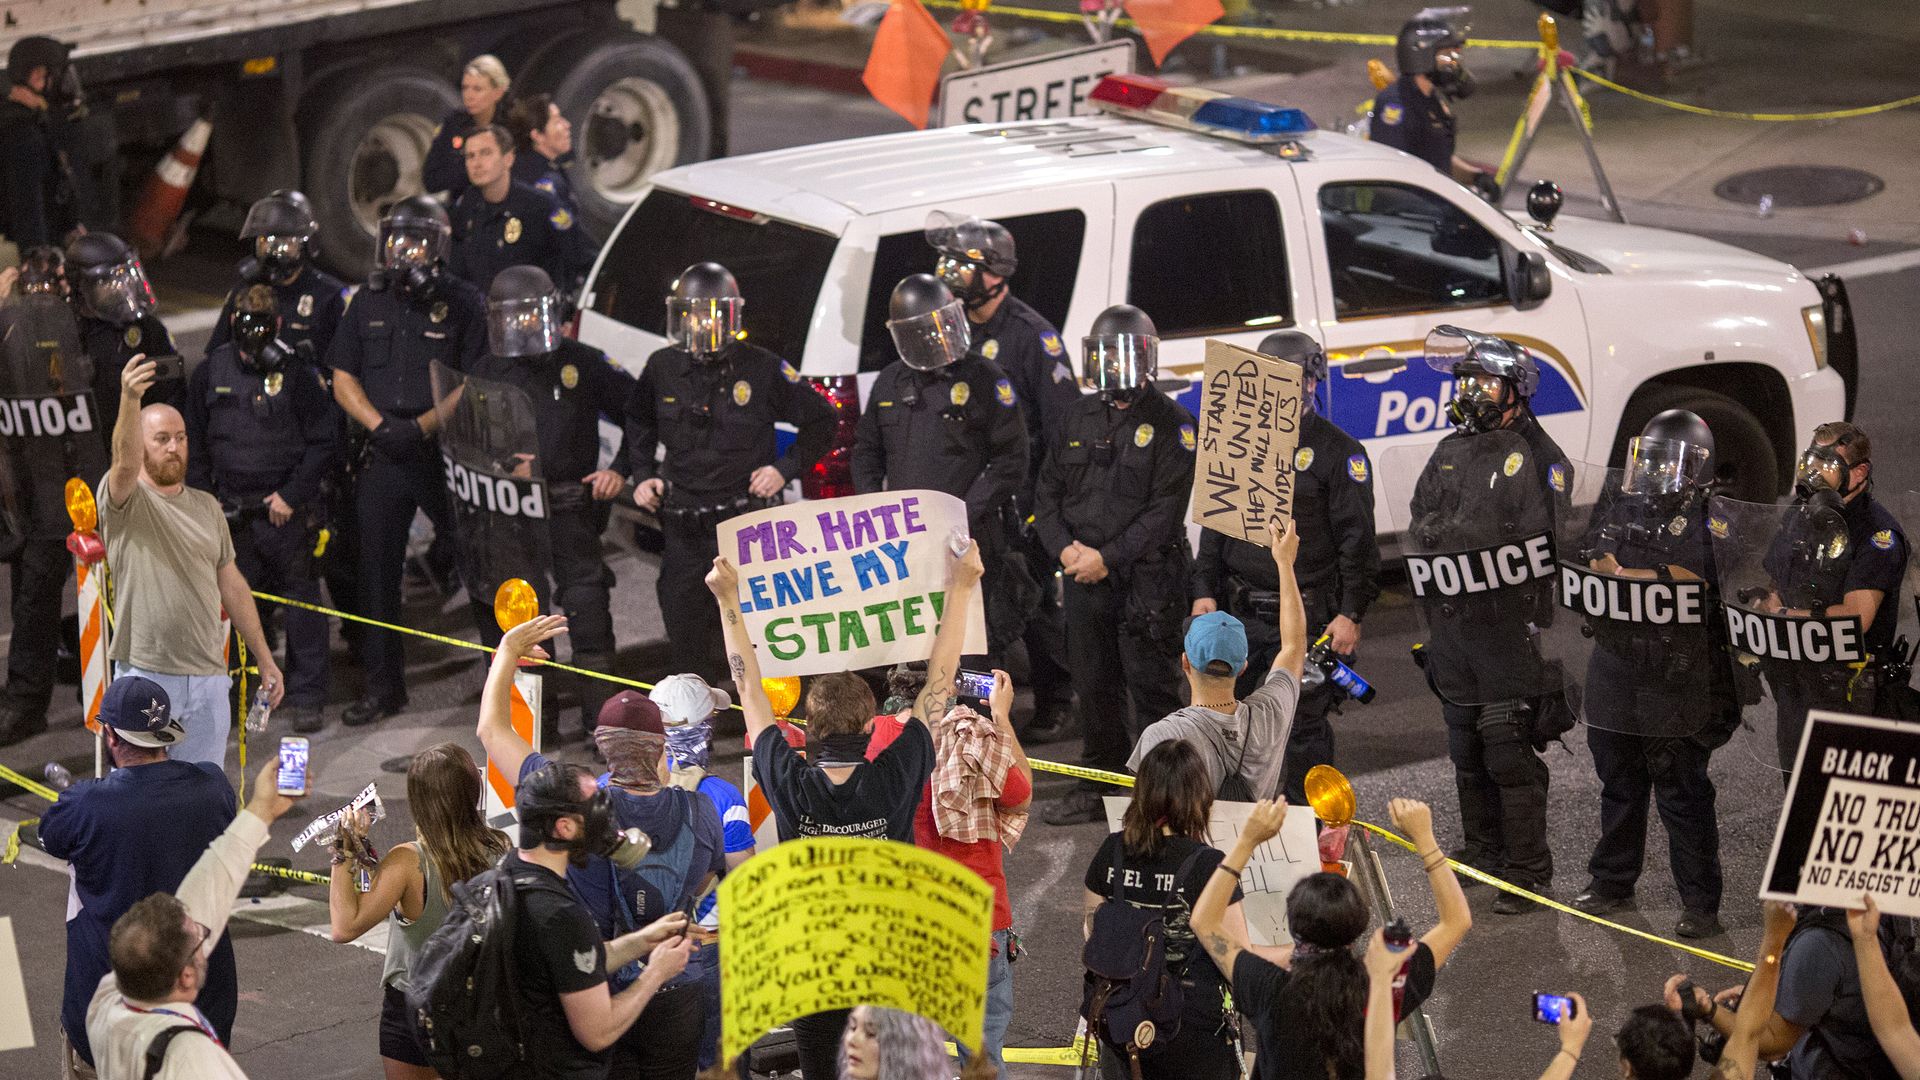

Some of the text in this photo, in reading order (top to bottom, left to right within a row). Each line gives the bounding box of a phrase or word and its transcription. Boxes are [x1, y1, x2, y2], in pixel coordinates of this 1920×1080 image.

[1257, 378, 1276, 430] NOT
[1203, 369, 1240, 518] WE STAND
[443, 454, 545, 518] POLICE
[1241, 477, 1278, 541] THEY
[1269, 453, 1292, 536] DIVIDE
[736, 497, 927, 566] MR. HATE
[850, 540, 910, 592] MY
[1407, 535, 1556, 597] POLICE
[1562, 567, 1701, 624] POLICE
[764, 591, 946, 662] STATE!
[1726, 606, 1860, 663] POLICE
[1821, 747, 1894, 781] BLACK
[1827, 791, 1867, 825] NO
[1814, 827, 1920, 874] NO KK
[1106, 867, 1185, 893] FEL TH
[1807, 866, 1832, 886] NO
[1835, 869, 1904, 895] FASCIST
